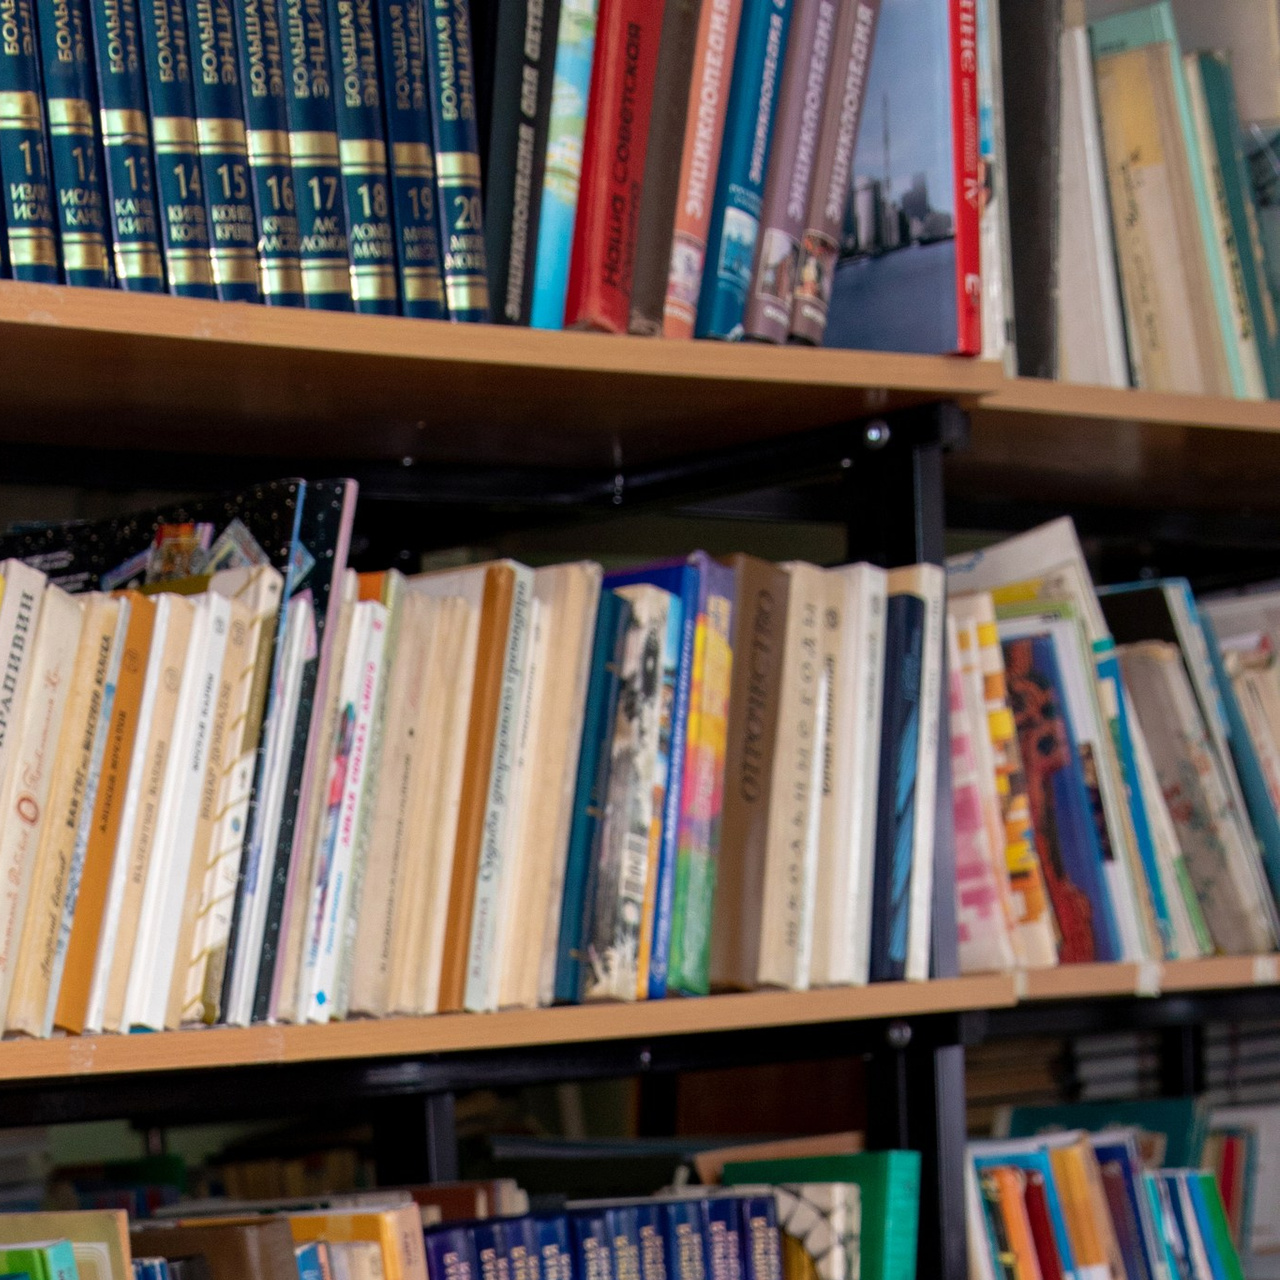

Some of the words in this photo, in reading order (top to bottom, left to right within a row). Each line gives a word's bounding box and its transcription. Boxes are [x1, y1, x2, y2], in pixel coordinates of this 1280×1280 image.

[19, 140, 46, 177] 11
[173, 163, 202, 200] 14
[217, 163, 247, 200] 15
[266, 175, 294, 212] 16
[307, 175, 338, 212] 17
[504, 124, 536, 319] ЭНЦИКЛОПЕДИЯ
[520, 65, 540, 117] ДЛЯ
[357, 182, 389, 219] 18
[407, 186, 435, 222] 19
[453, 195, 483, 231] 20
